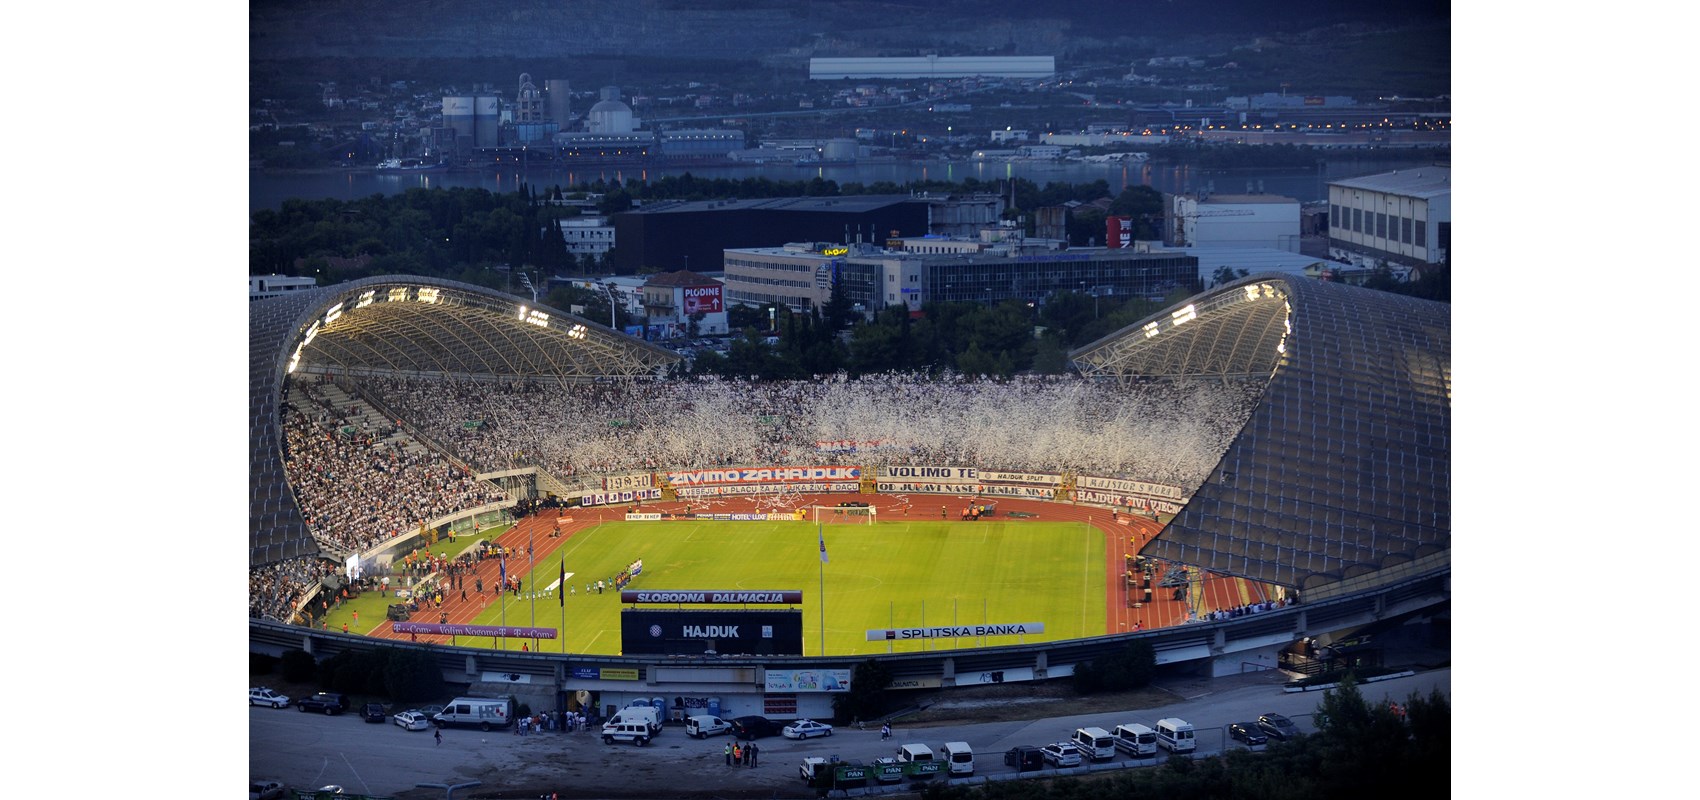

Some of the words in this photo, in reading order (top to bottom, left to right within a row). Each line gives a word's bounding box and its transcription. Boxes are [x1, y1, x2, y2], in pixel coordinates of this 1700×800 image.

[685, 287, 720, 297] PLODINE
[742, 469, 773, 482] ZA
[775, 467, 858, 481] HAJDUK
[888, 467, 951, 478] VOLIMO
[1089, 479, 1136, 491] MAJSTOR
[637, 593, 705, 603] SLOBODNA
[711, 593, 784, 603] DALMACIJA
[439, 625, 465, 636] Volim
[682, 625, 739, 638] HAJDUK
[901, 627, 971, 639] SPLITSKA
[975, 625, 1027, 636] BANKA
[885, 767, 902, 775] PAN
[921, 765, 938, 773] PAN
[846, 771, 864, 779] PAN
